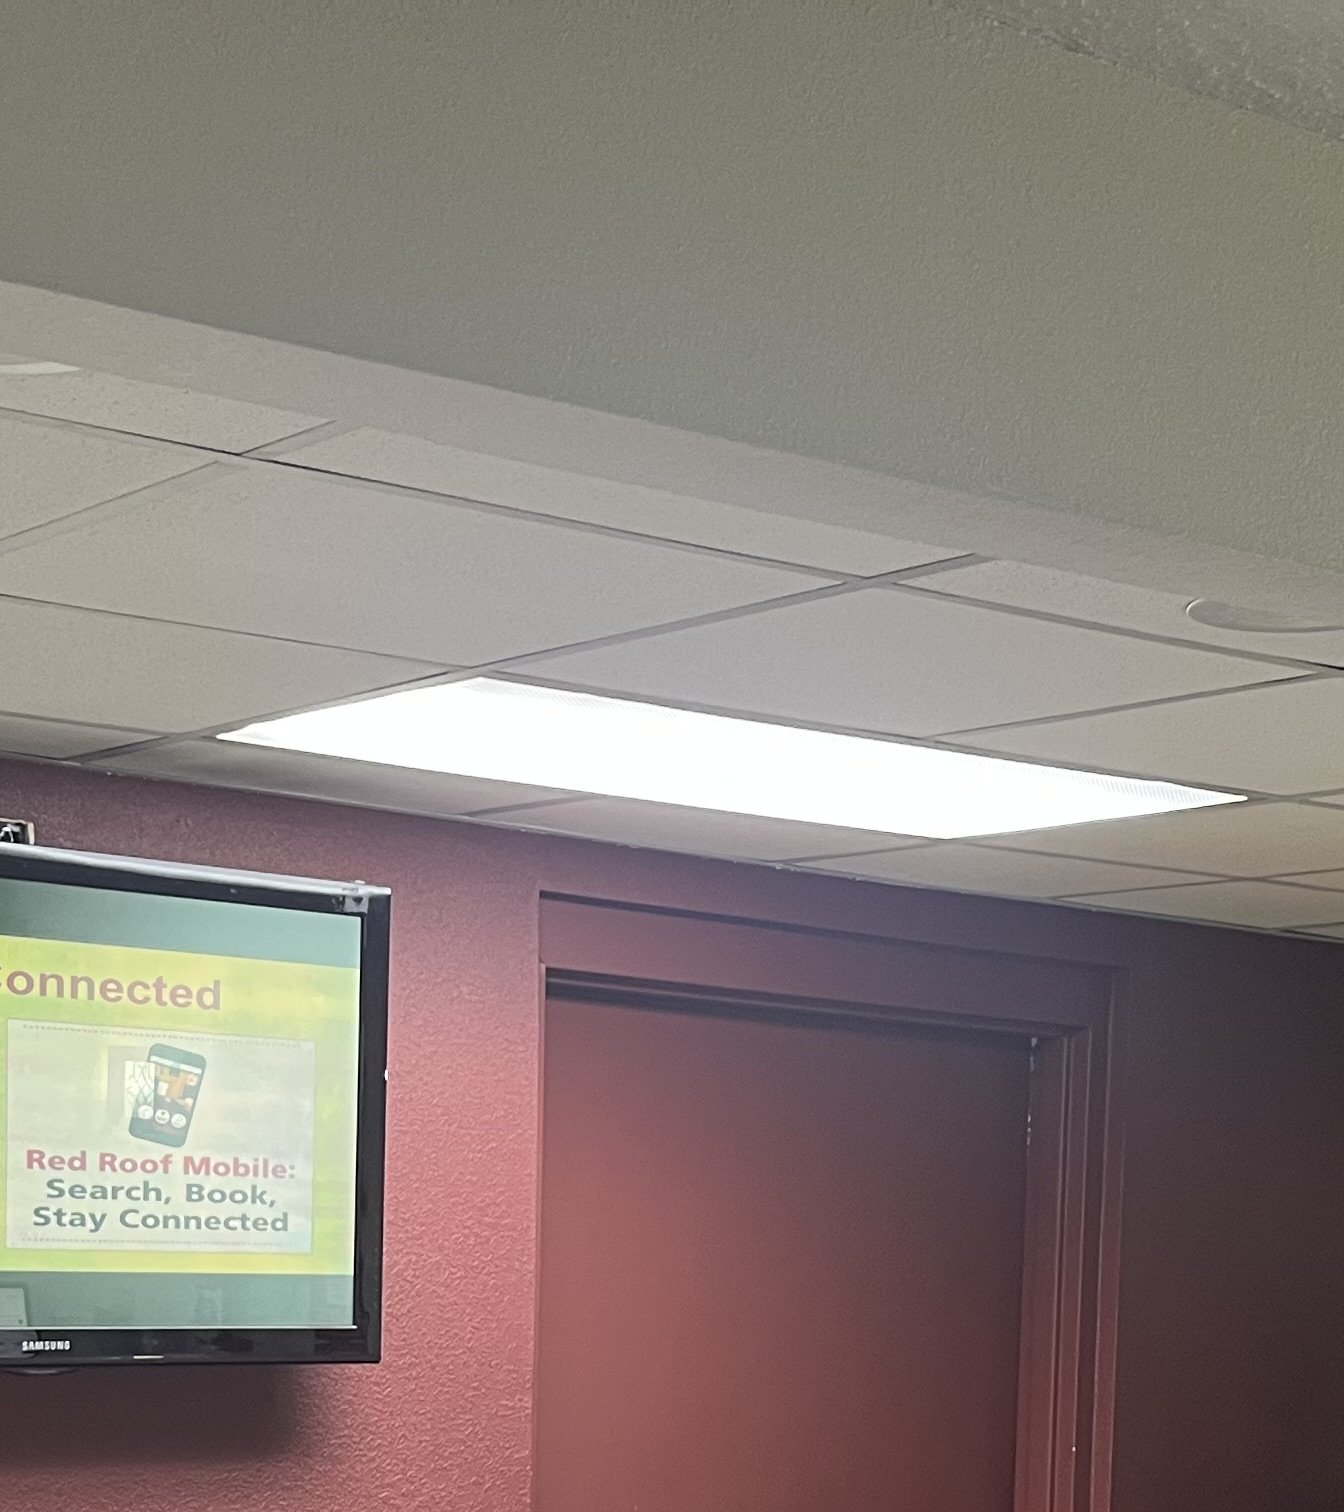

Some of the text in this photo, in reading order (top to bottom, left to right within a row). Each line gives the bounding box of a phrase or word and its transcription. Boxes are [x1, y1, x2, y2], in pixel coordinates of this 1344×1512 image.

[26, 1149, 296, 1180] Red Roof Mobile:
[46, 1178, 276, 1208] Search, Book,
[32, 1206, 289, 1233] Stay Connected
[21, 1340, 71, 1351] SAMSUNG
